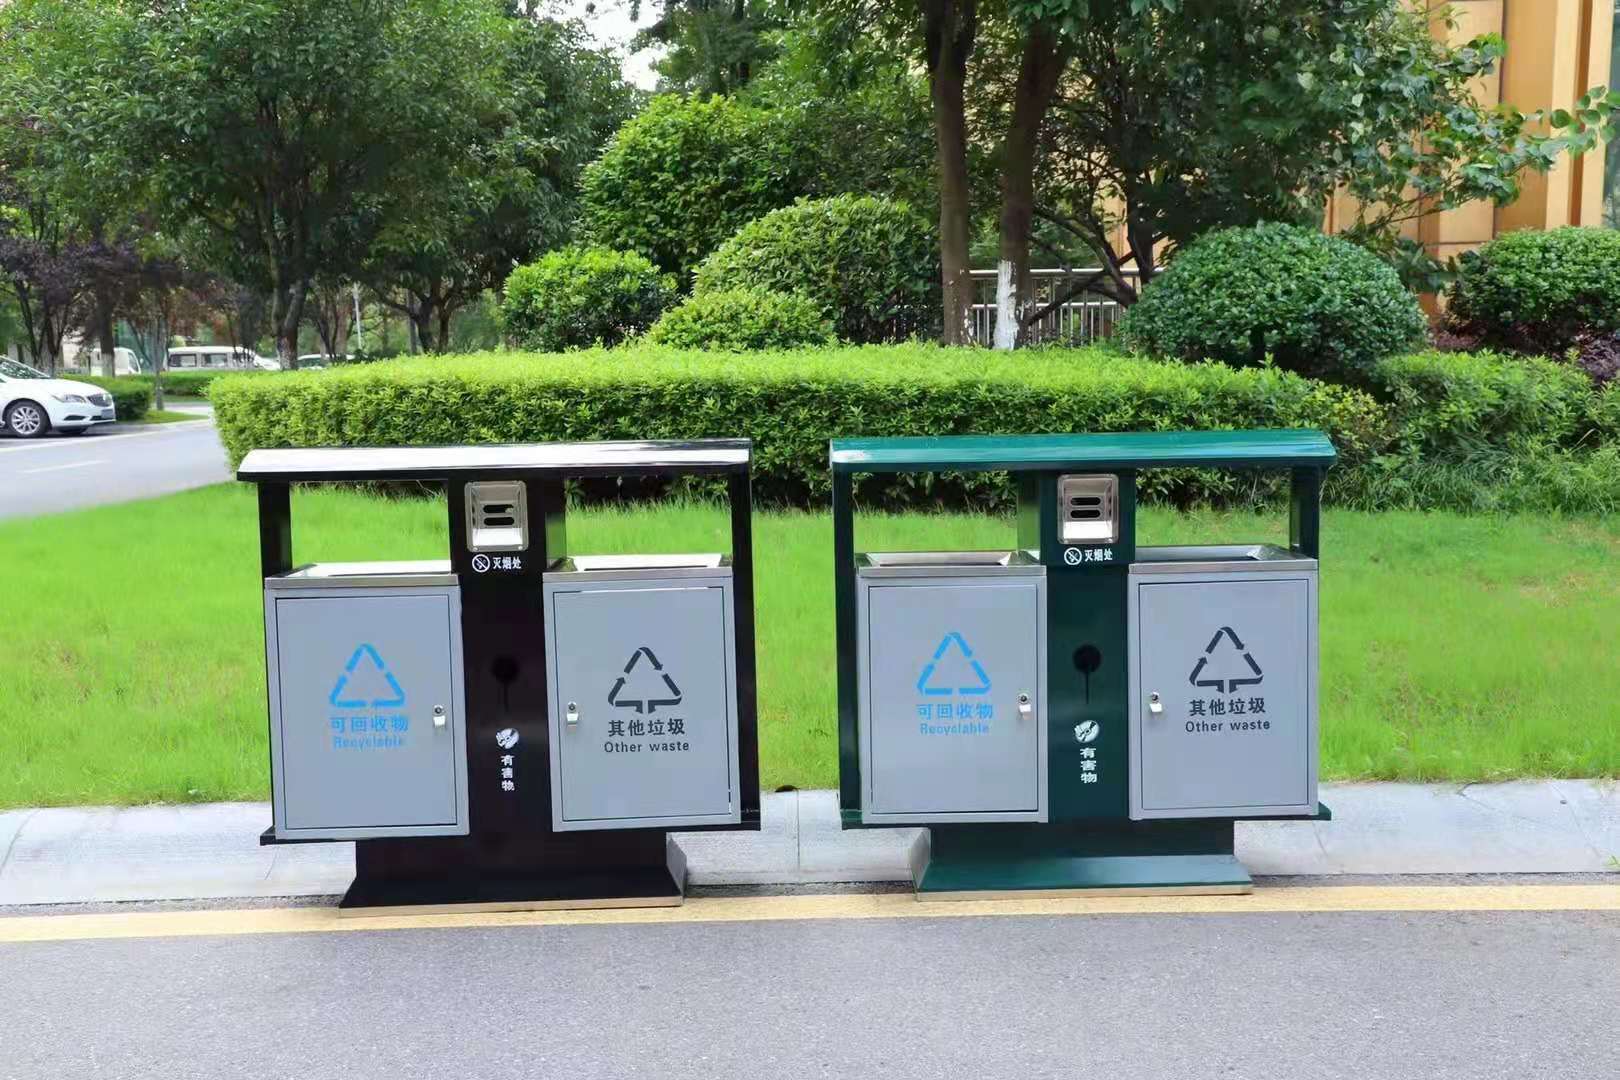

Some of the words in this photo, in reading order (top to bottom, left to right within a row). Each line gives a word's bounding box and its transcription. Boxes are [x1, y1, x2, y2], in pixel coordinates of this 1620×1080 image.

[492, 556, 522, 570] 灭烟处
[1084, 548, 1113, 562] 灭烟处
[918, 702, 993, 720] 可回收物
[1189, 697, 1267, 716] 其他垃圾
[330, 715, 409, 734] 可回收物
[607, 718, 686, 737] 其他垃圾
[1185, 720, 1223, 733] Other
[1230, 718, 1271, 731] waste
[604, 741, 643, 753] Other
[649, 739, 689, 752] waste
[501, 754, 515, 792] 有害物
[1080, 747, 1098, 784] 有害物
